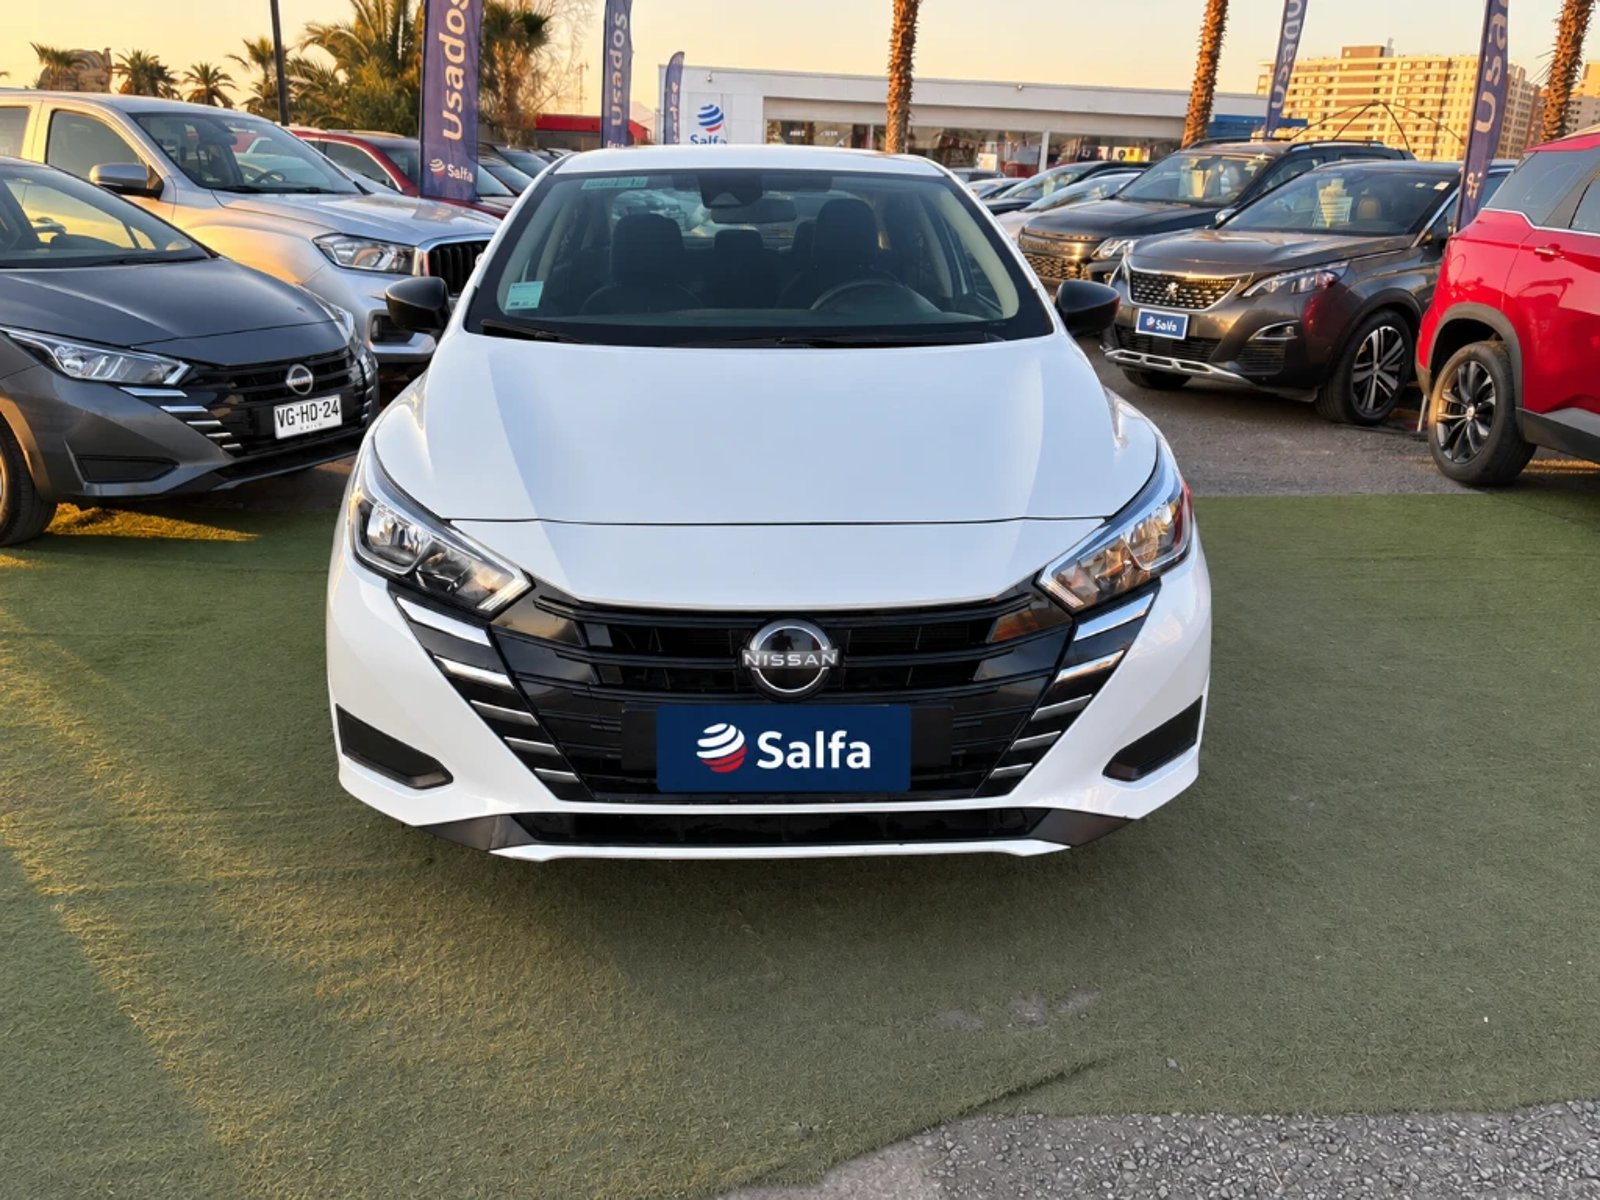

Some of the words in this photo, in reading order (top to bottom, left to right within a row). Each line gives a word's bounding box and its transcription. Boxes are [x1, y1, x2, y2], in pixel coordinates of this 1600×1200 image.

[609, 12, 627, 126] usados
[447, 164, 474, 183] Salfa
[744, 652, 837, 667] NISSAN
[756, 730, 872, 769] Salfa
